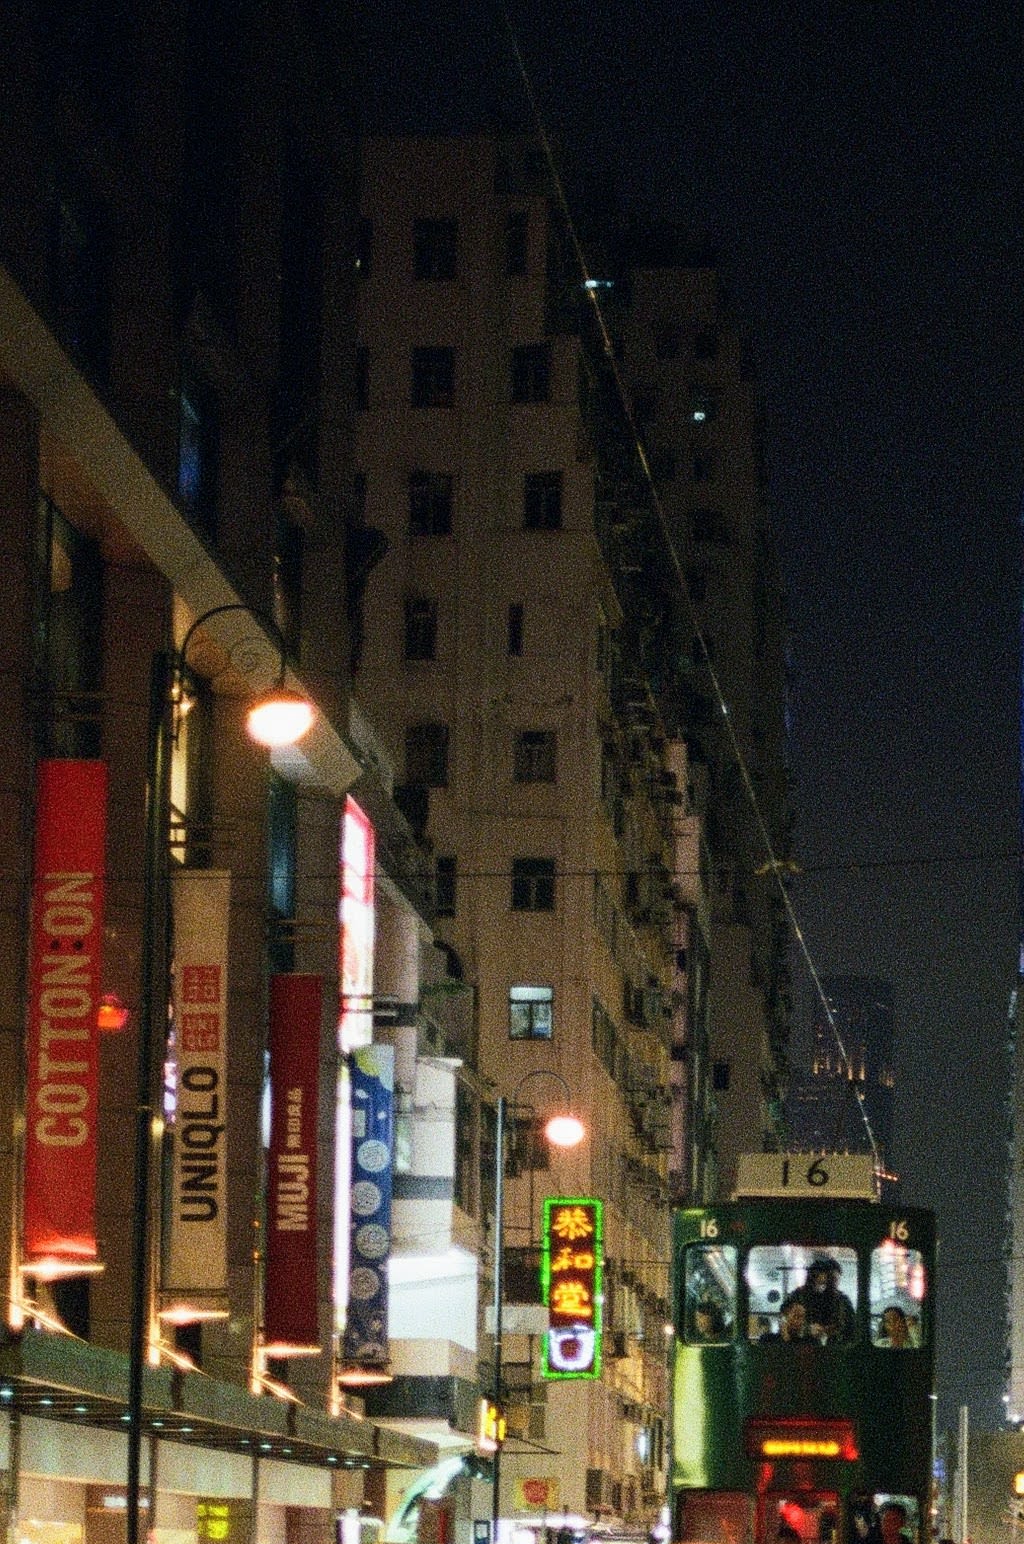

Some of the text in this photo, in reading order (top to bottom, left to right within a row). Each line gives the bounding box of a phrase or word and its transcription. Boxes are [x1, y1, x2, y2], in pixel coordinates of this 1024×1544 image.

[35, 871, 95, 1147] COTTON:ON
[180, 1066, 225, 1222] UNIQLO
[276, 1154, 310, 1231] MUJI
[781, 1157, 829, 1187] 16
[700, 1219, 719, 1238] 16
[890, 1220, 909, 1240] 16
